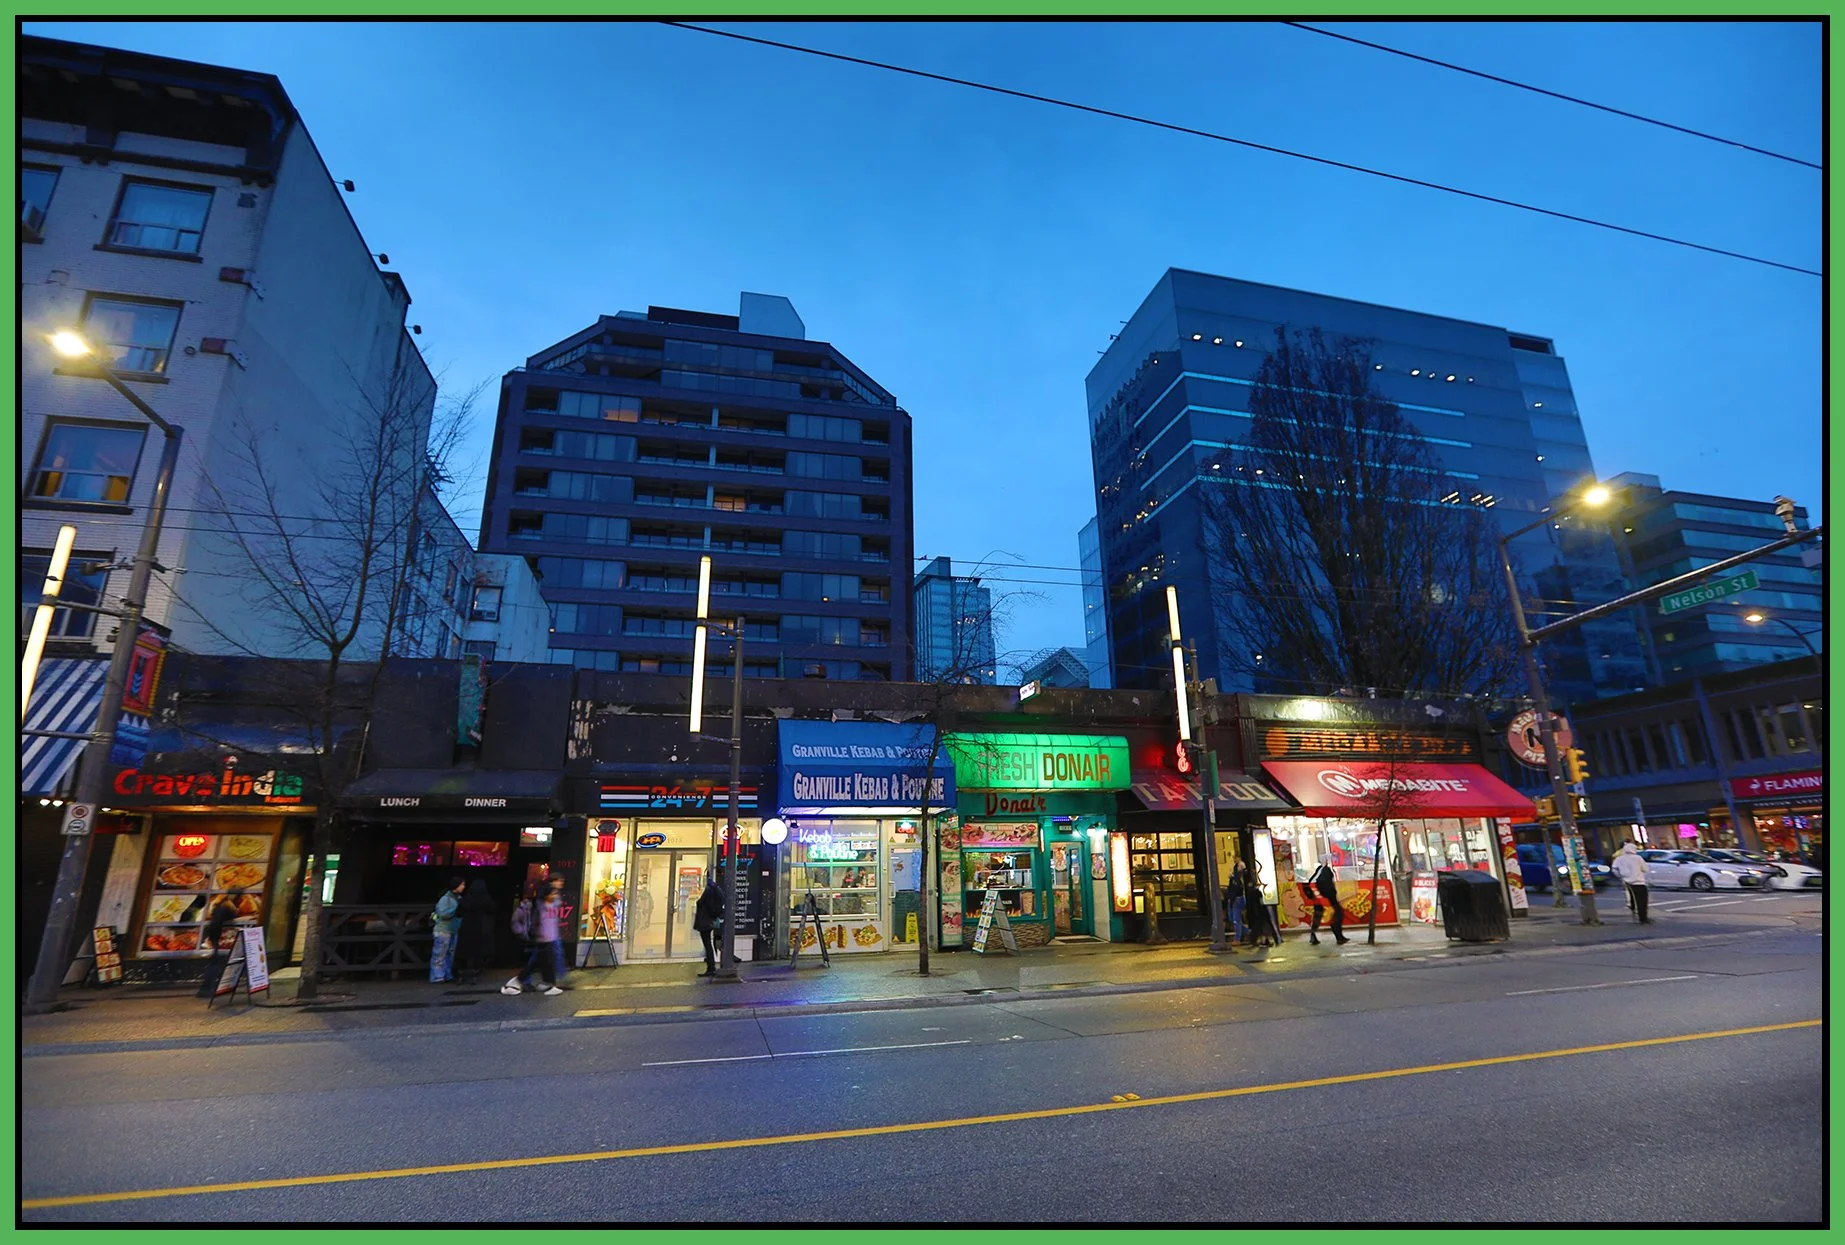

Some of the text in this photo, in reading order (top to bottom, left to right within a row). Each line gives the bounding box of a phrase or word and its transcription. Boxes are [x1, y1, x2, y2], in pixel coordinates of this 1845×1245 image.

[1669, 577, 1749, 610] Nelson St
[792, 744, 849, 758] GRANVILLE
[849, 745, 885, 759] KEBAB
[886, 746, 896, 759] &
[976, 751, 1111, 781] FRESH DONAIR
[113, 768, 216, 796] Crave
[793, 772, 945, 801] GRANVILLE KEBAB & POUTNE
[1361, 778, 1468, 792] MEGABITE
[1763, 775, 1823, 791] FLAMIN
[380, 797, 420, 807] LUNCH
[464, 798, 507, 807] DINNER
[985, 792, 1047, 816] Donair
